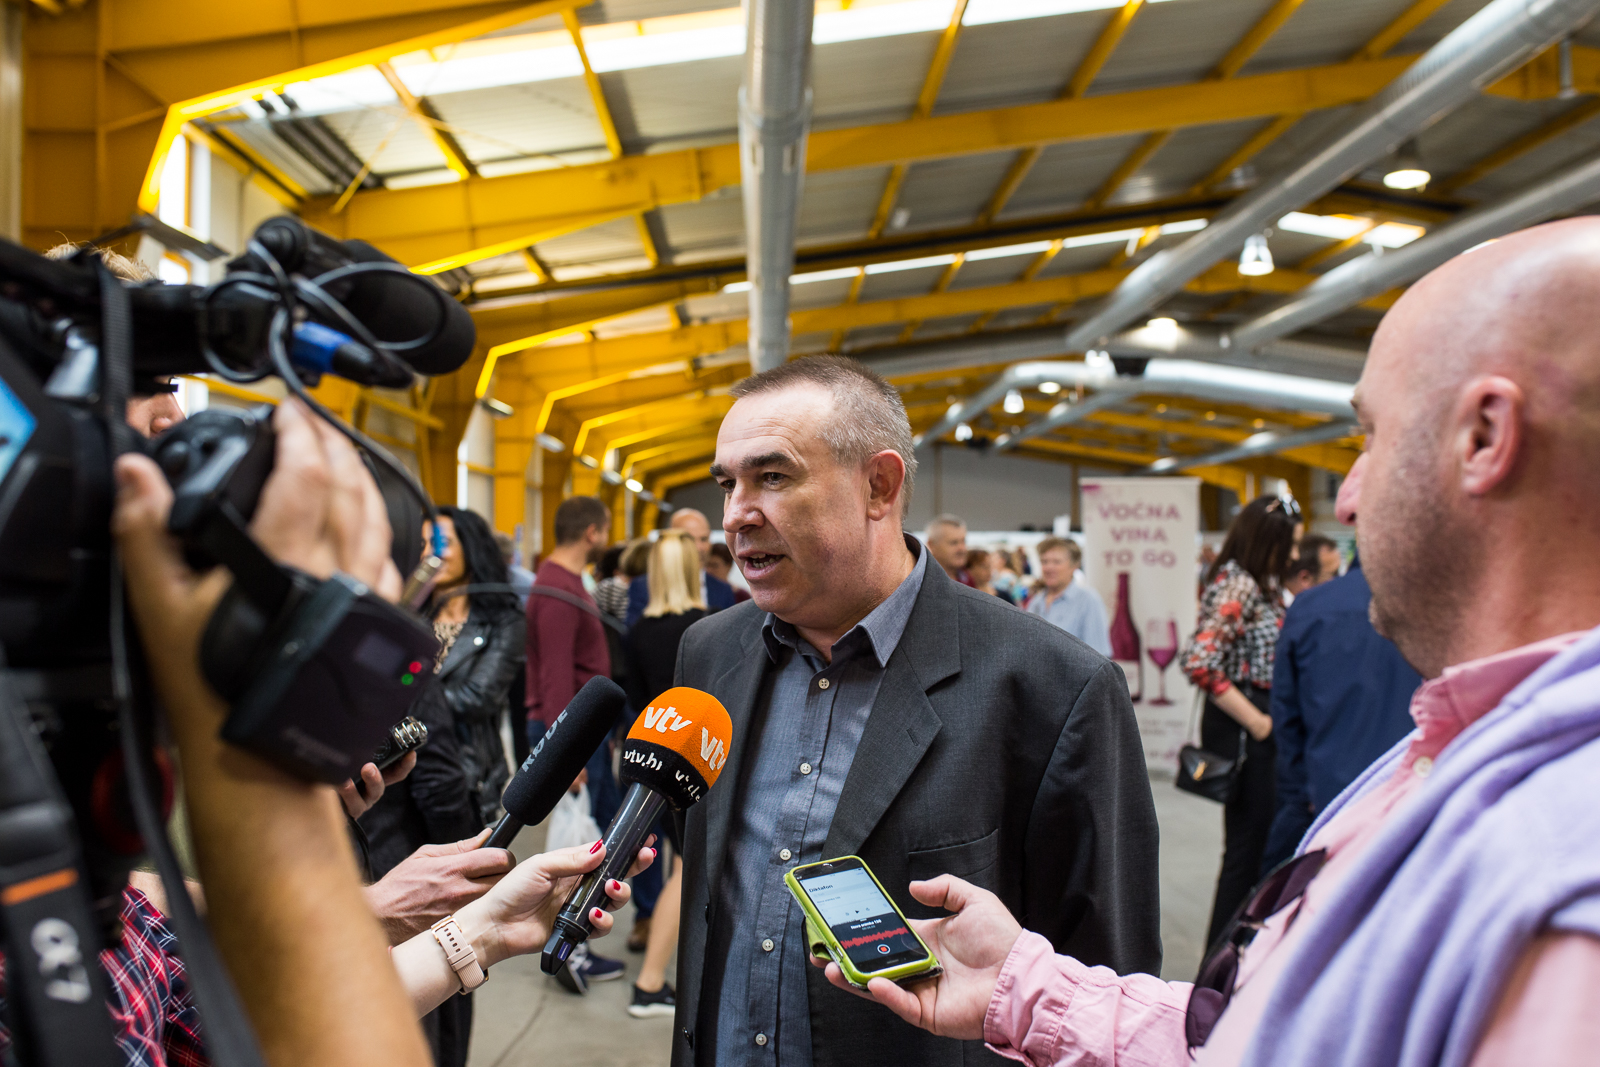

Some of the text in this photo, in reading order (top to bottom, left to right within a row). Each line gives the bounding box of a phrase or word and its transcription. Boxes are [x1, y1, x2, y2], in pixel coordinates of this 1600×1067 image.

[1110, 527, 1168, 543] VINA
[1102, 548, 1177, 569] TO GO
[643, 706, 693, 734] vtv
